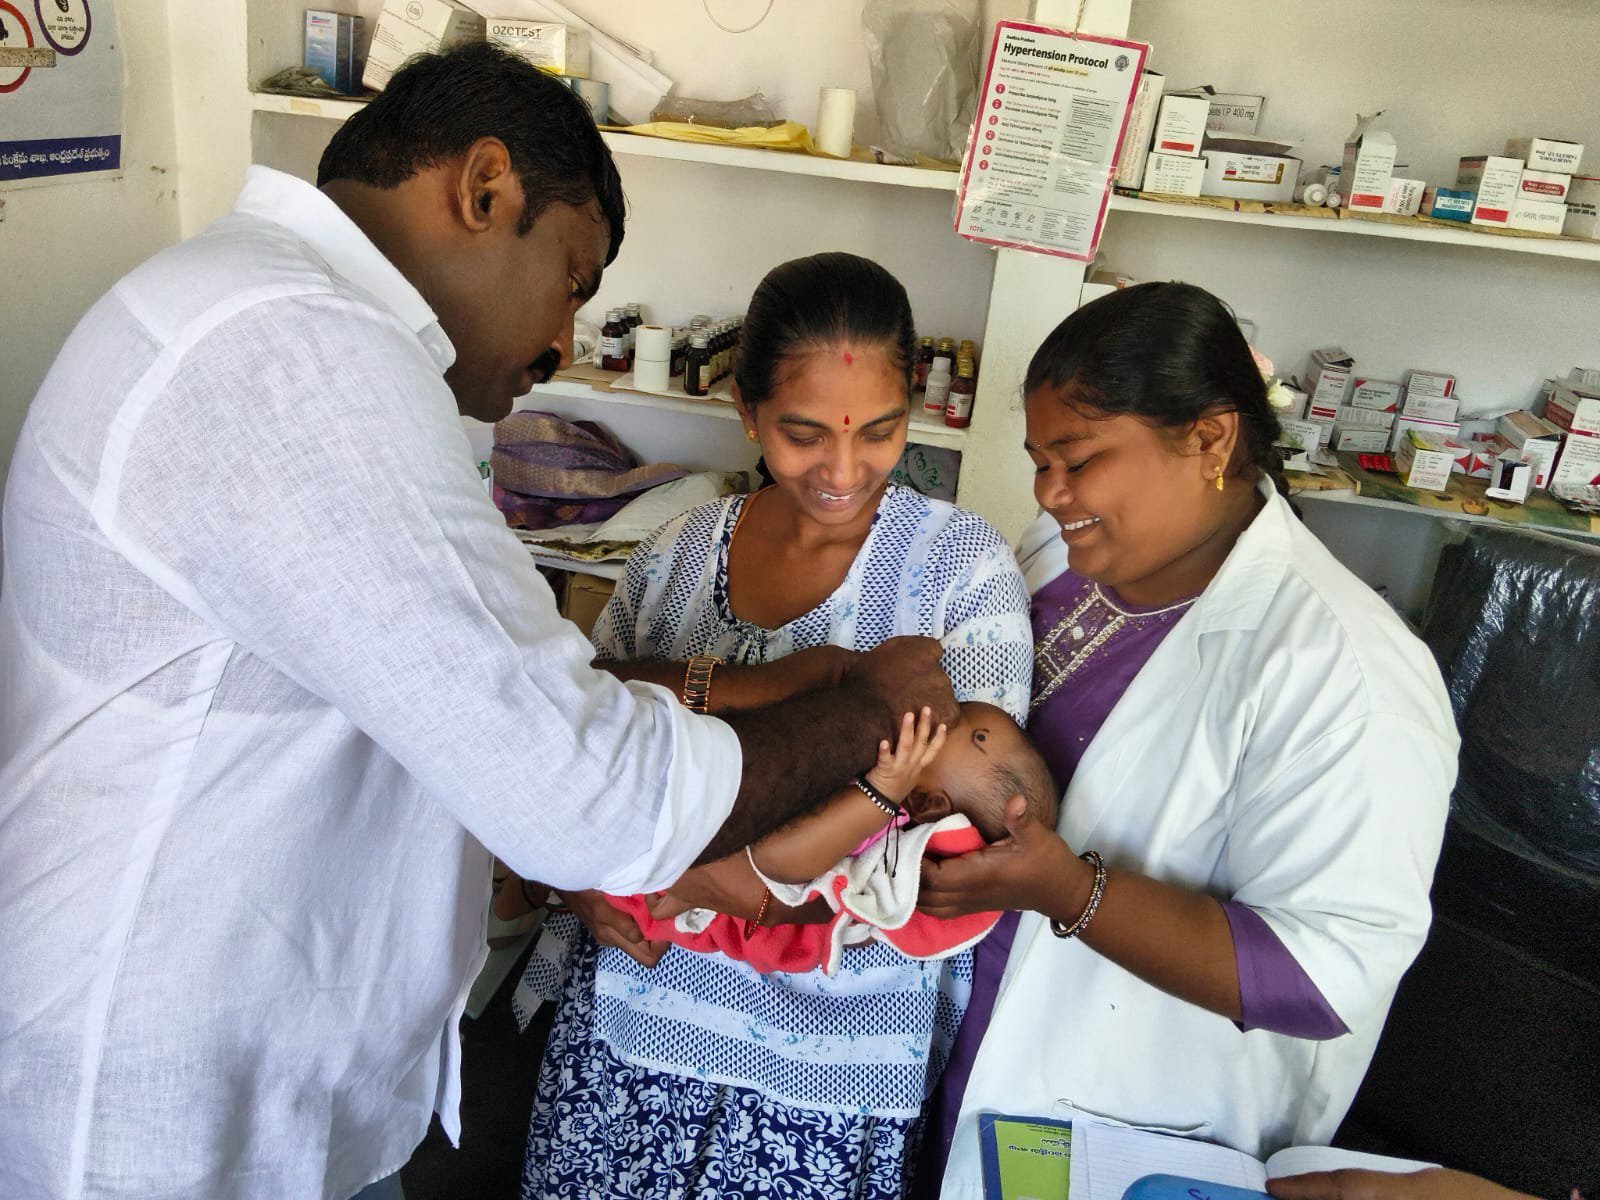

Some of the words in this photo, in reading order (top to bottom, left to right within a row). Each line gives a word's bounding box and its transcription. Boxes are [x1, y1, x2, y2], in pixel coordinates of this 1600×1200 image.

[1003, 42, 1067, 62] Hypertension
[1068, 53, 1109, 69] Protocol
[1232, 107, 1245, 118] 400
[1244, 111, 1255, 121] mg
